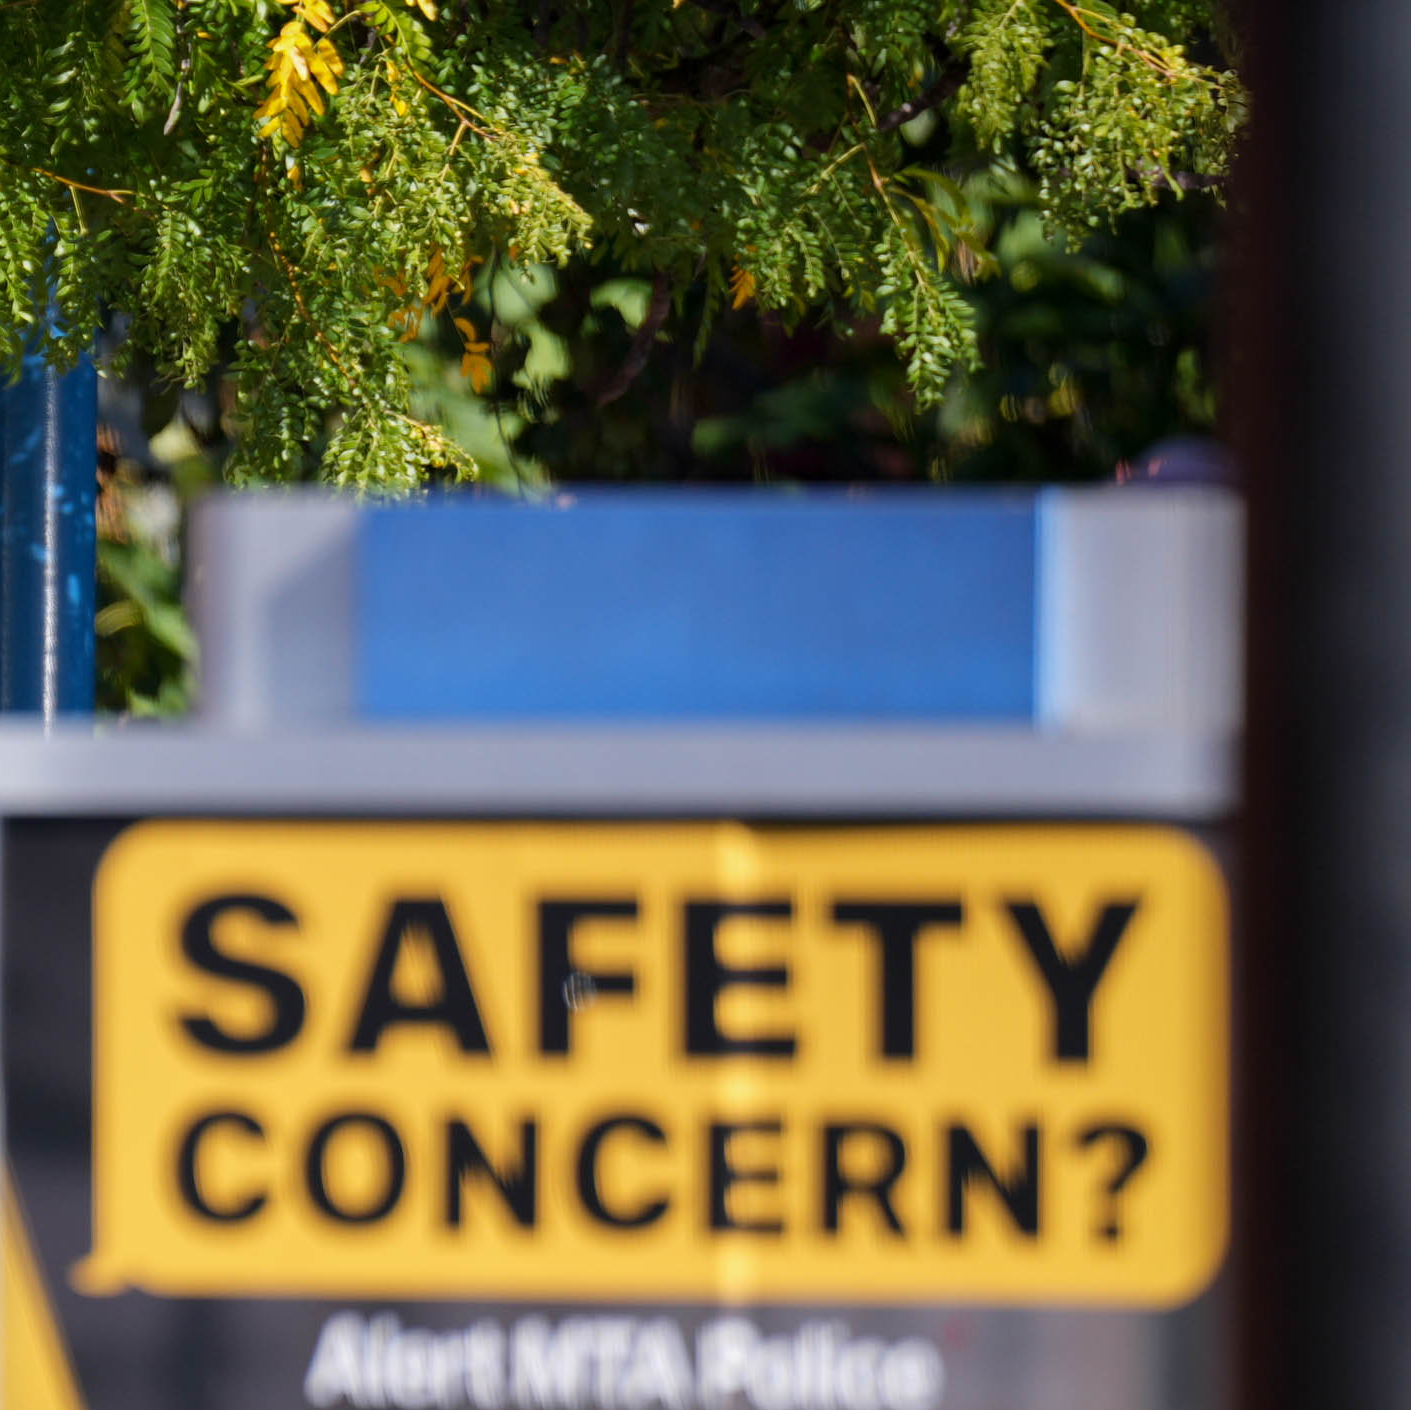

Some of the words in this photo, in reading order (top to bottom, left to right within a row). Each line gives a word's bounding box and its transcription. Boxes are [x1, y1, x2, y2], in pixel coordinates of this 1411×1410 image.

[179, 892, 1141, 1065] SAFETY
[179, 1111, 1152, 1244] CONCERN?
[307, 1313, 505, 1409] Alert
[509, 1316, 693, 1410] MTA
